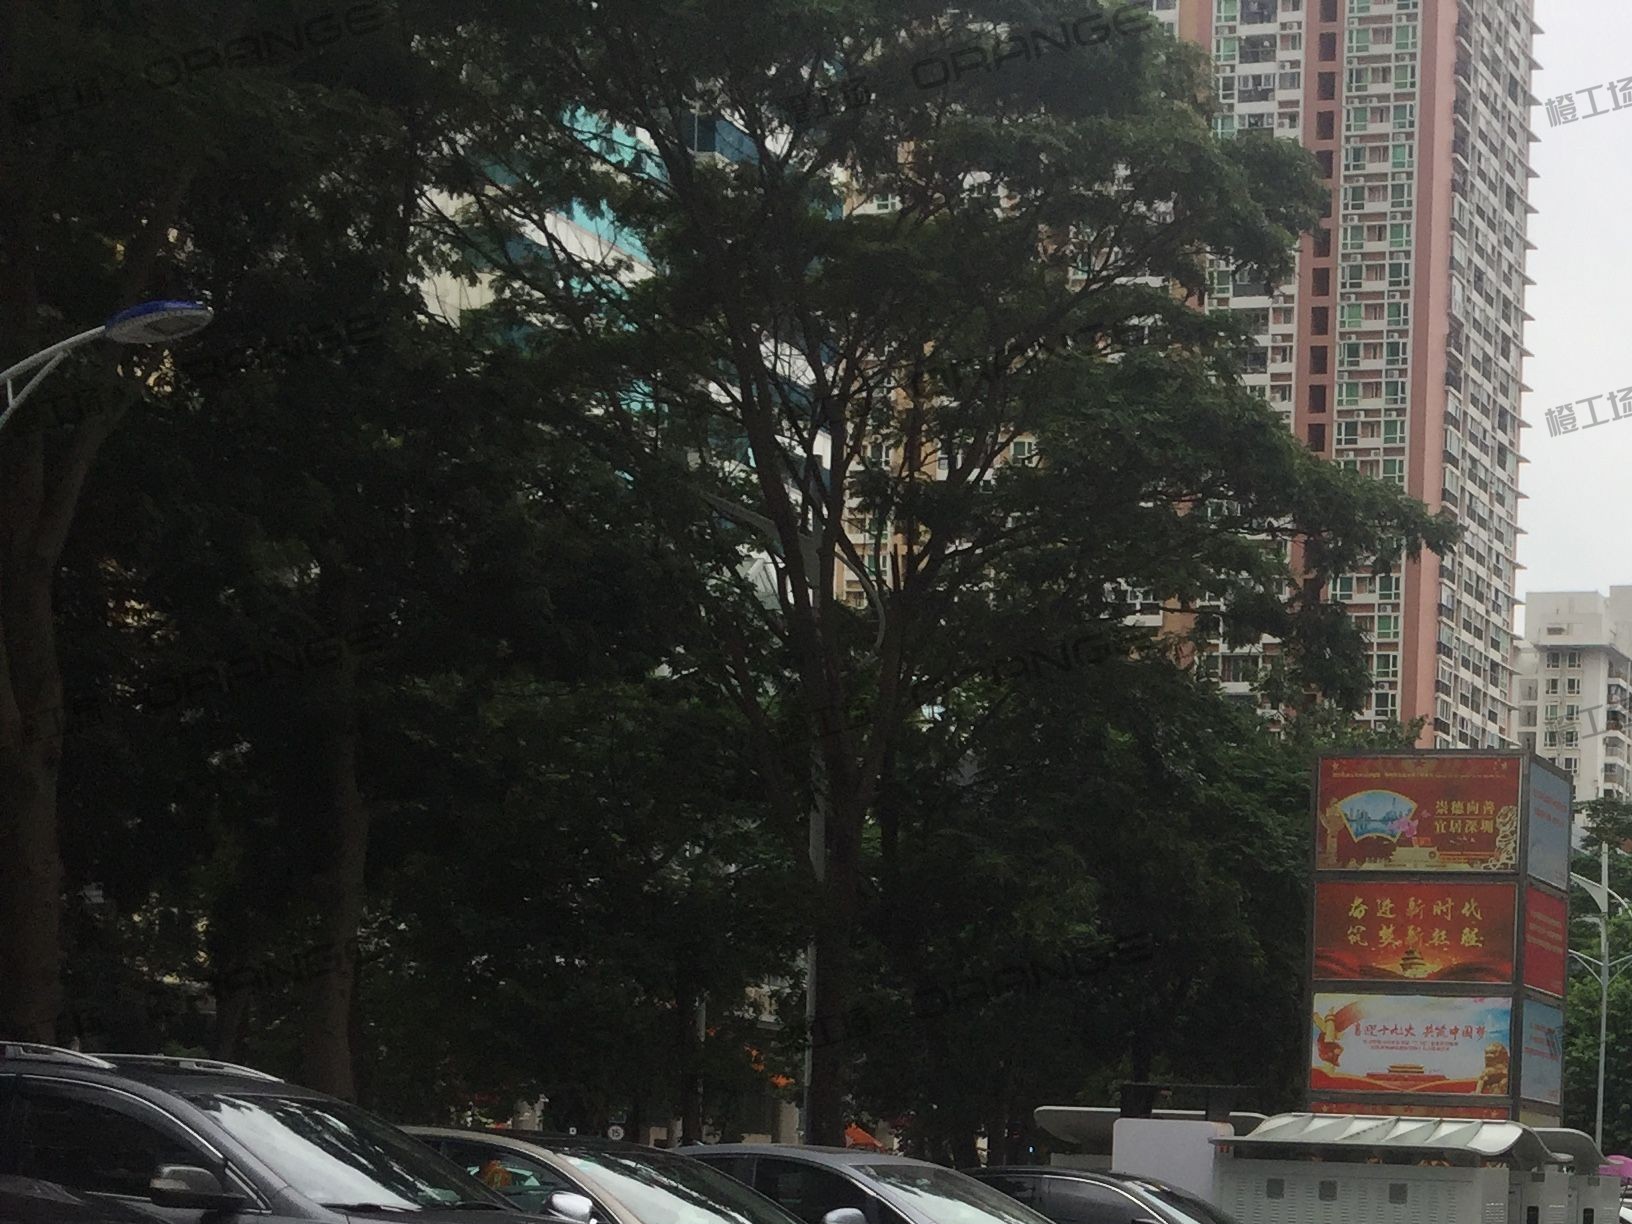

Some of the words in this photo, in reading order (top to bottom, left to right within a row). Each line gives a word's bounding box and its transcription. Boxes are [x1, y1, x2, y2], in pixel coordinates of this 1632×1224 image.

[1435, 799, 1496, 815] 崇德向善
[1434, 819, 1495, 834] 宜居深圳
[1347, 895, 1484, 921] 奋进新时代
